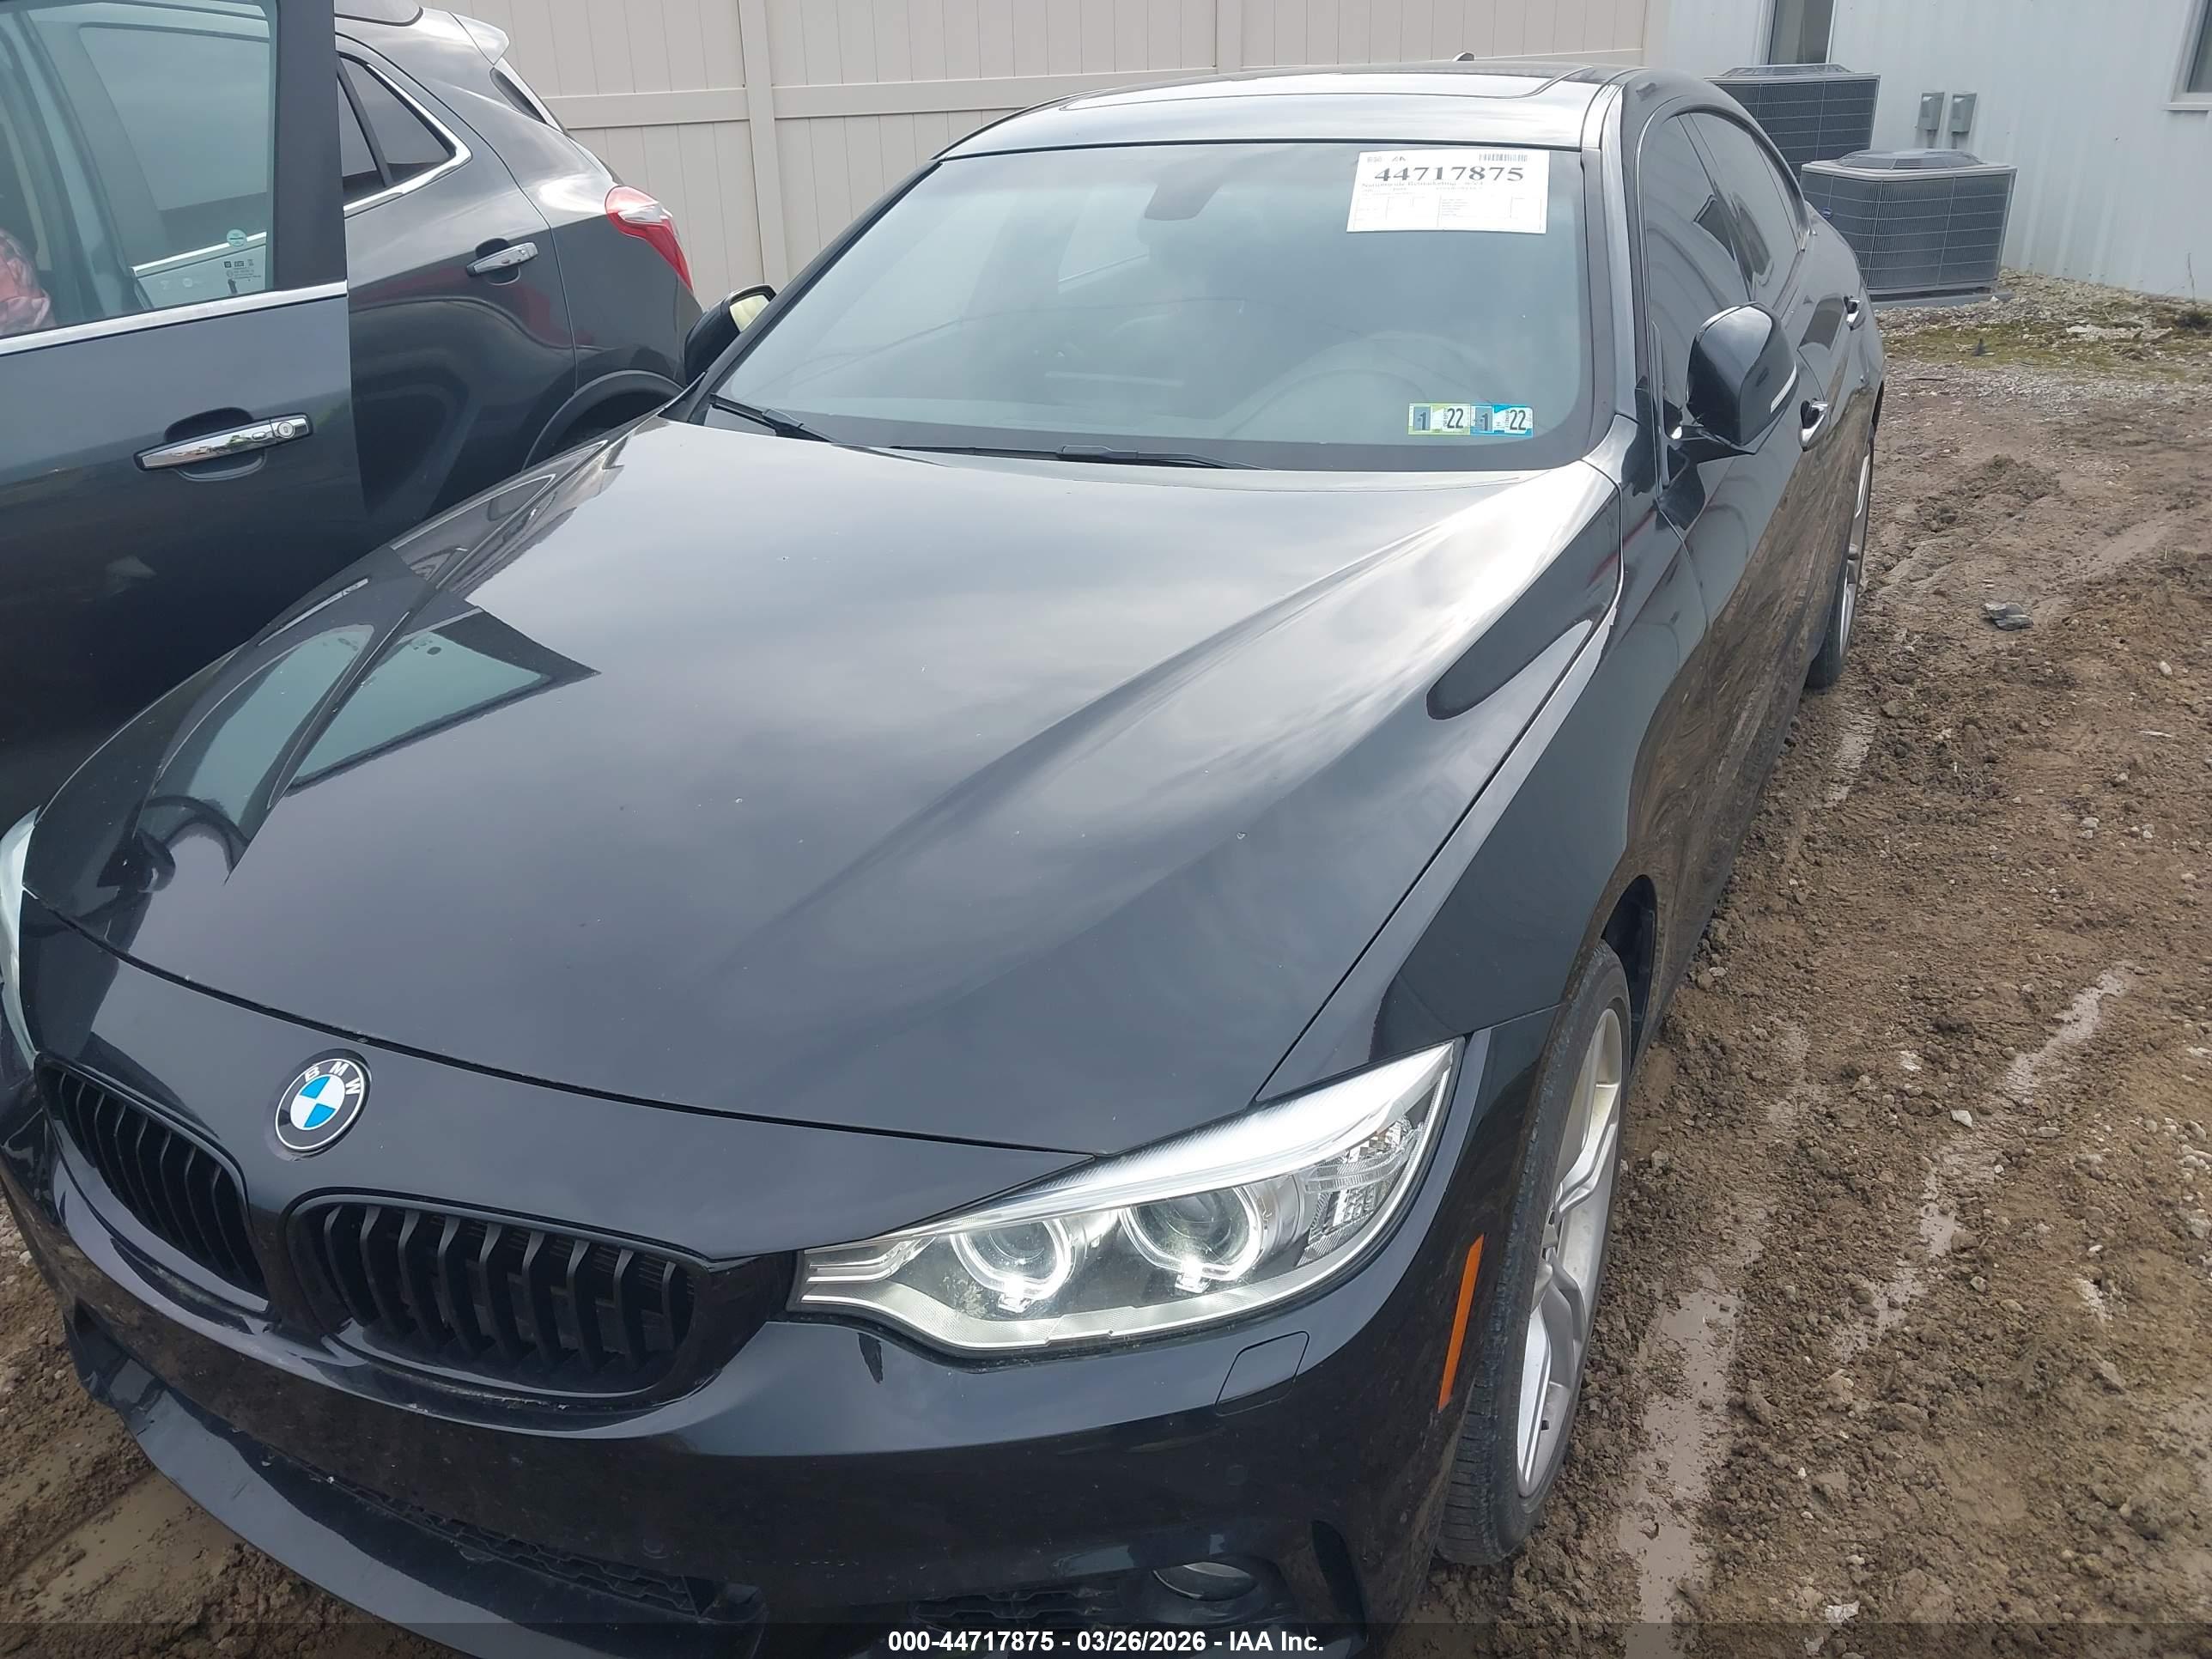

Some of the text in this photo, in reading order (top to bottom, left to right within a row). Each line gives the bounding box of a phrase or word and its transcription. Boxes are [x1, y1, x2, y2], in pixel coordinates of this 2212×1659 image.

[1374, 166, 1524, 182] 44717875
[1419, 411, 1427, 431] 1
[1447, 408, 1464, 428] 22
[1510, 410, 1527, 431] 22
[304, 1060, 362, 1096] BMW
